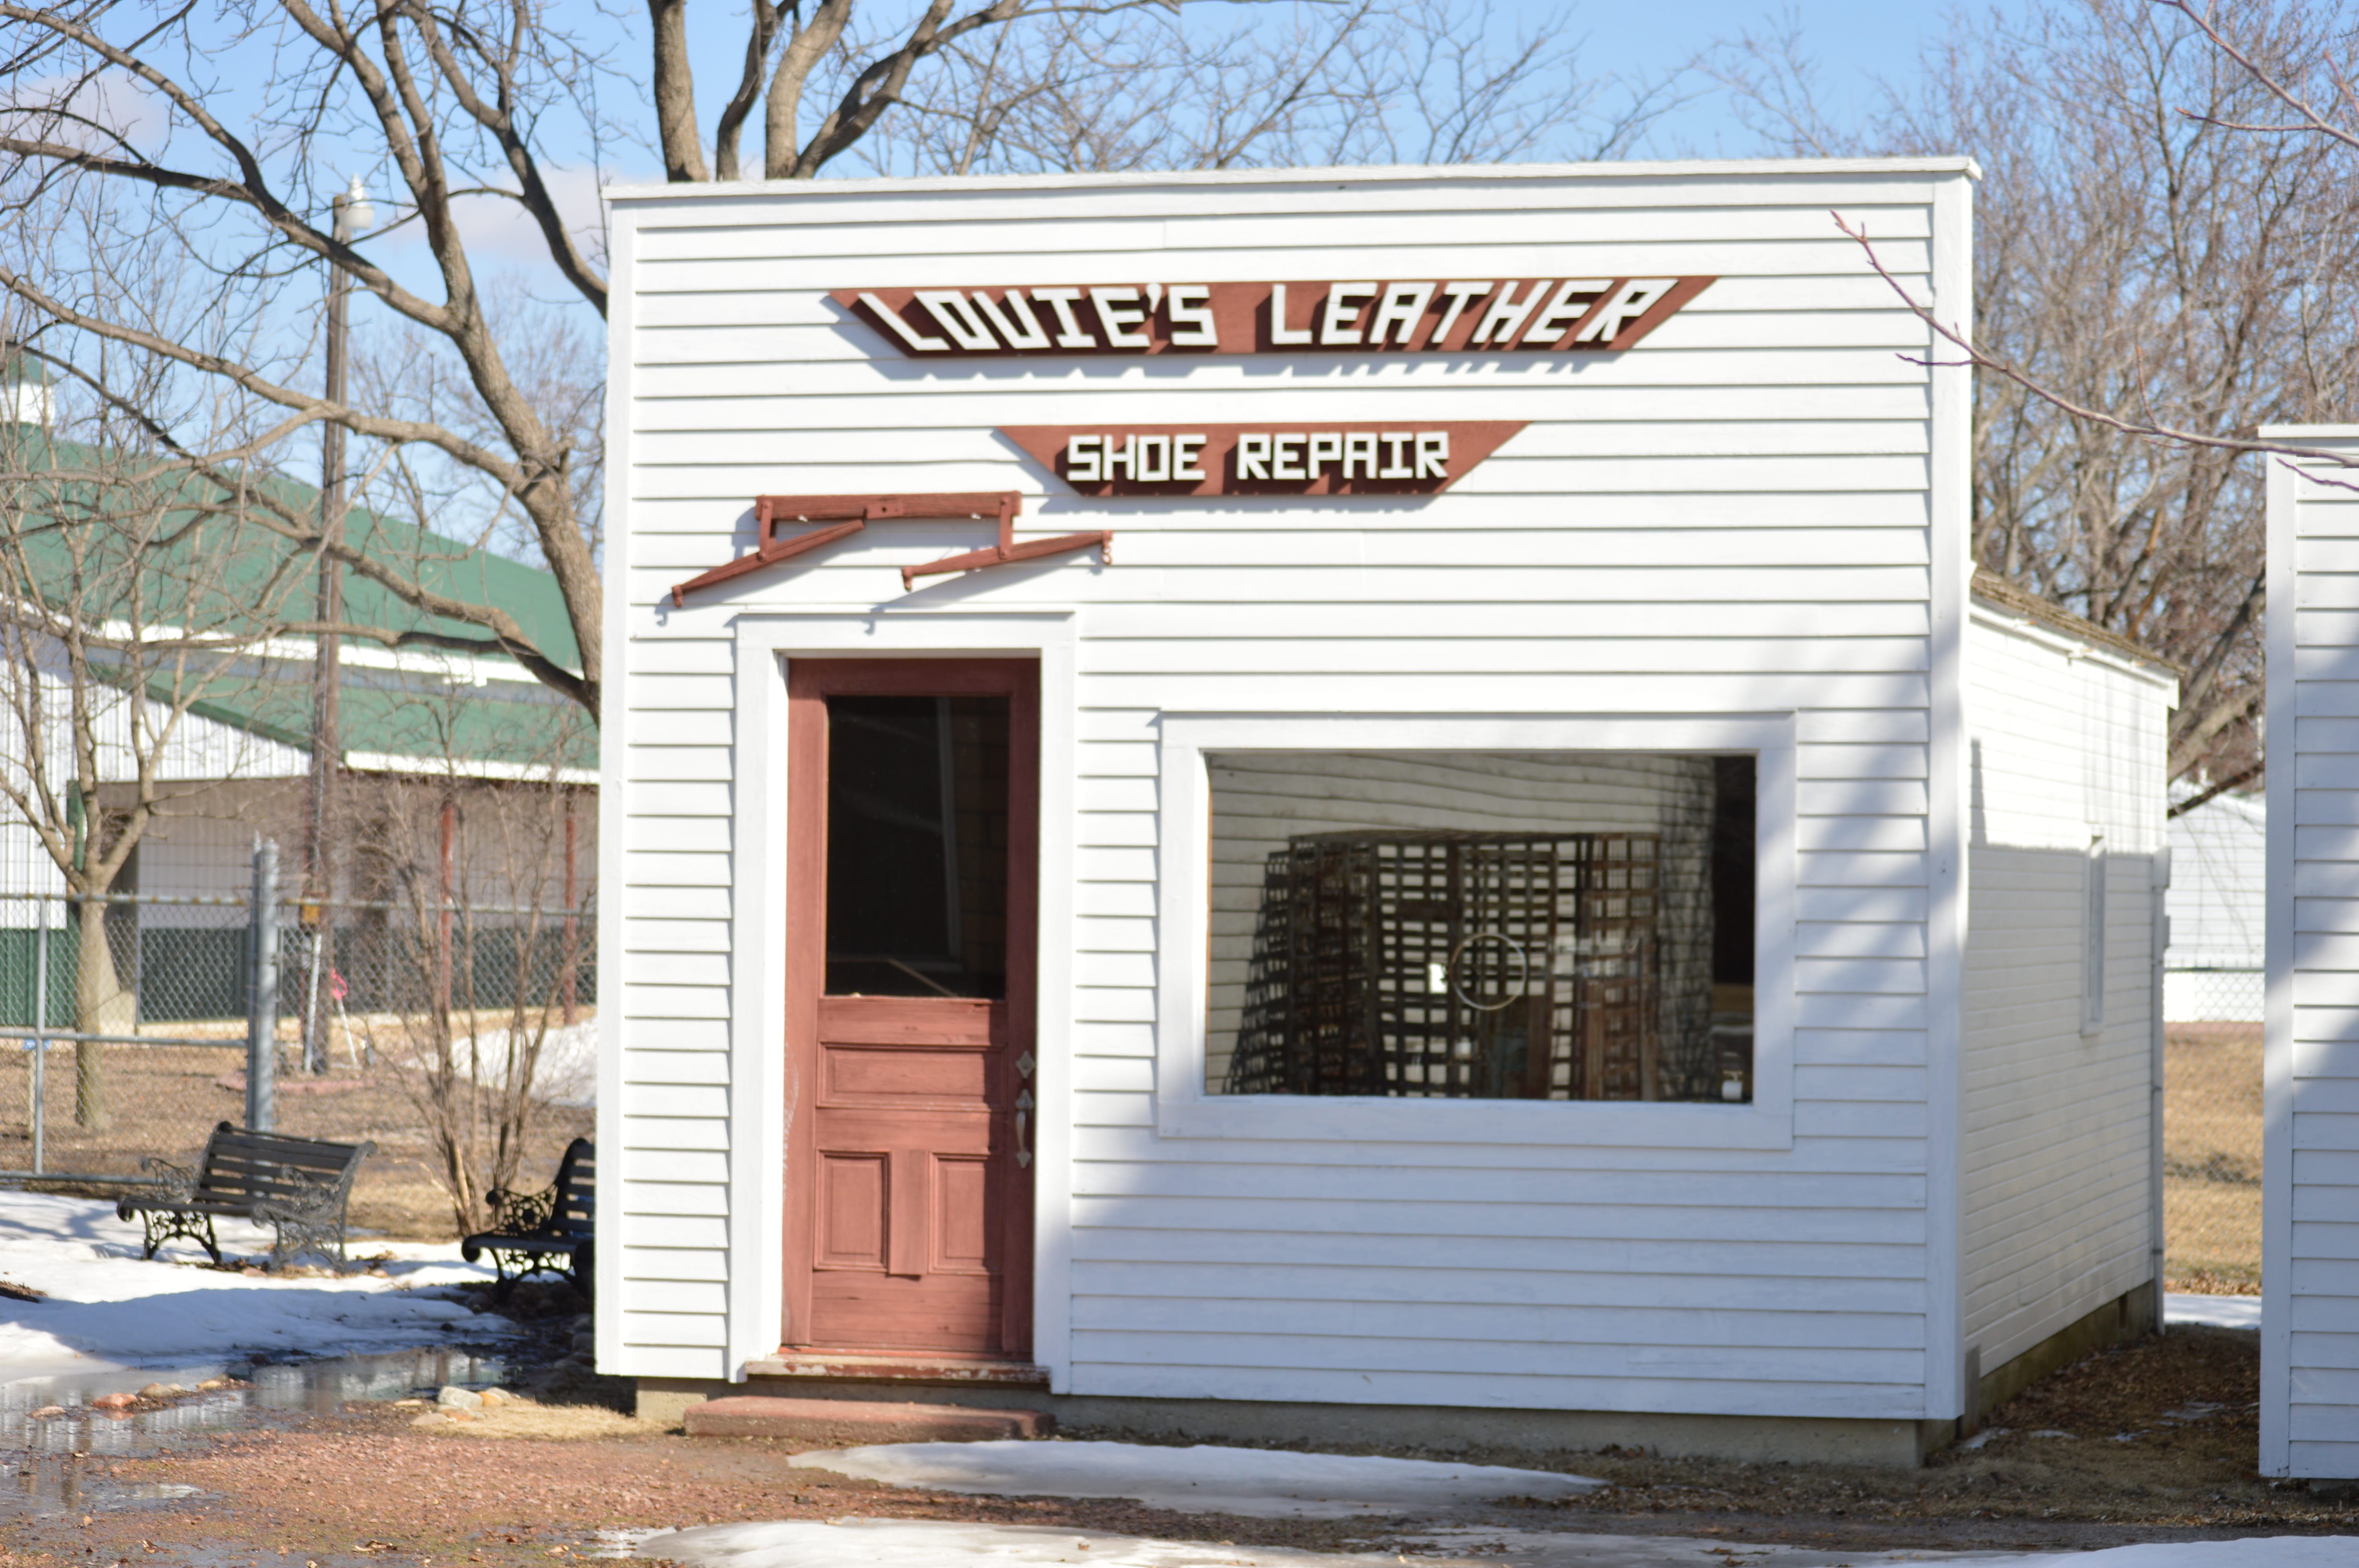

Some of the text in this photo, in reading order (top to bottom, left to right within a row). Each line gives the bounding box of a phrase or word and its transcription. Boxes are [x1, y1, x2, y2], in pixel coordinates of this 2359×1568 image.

[858, 278, 1679, 350] LOUIE'S LEATHER
[1067, 431, 1449, 481] SHOE REPAIR
